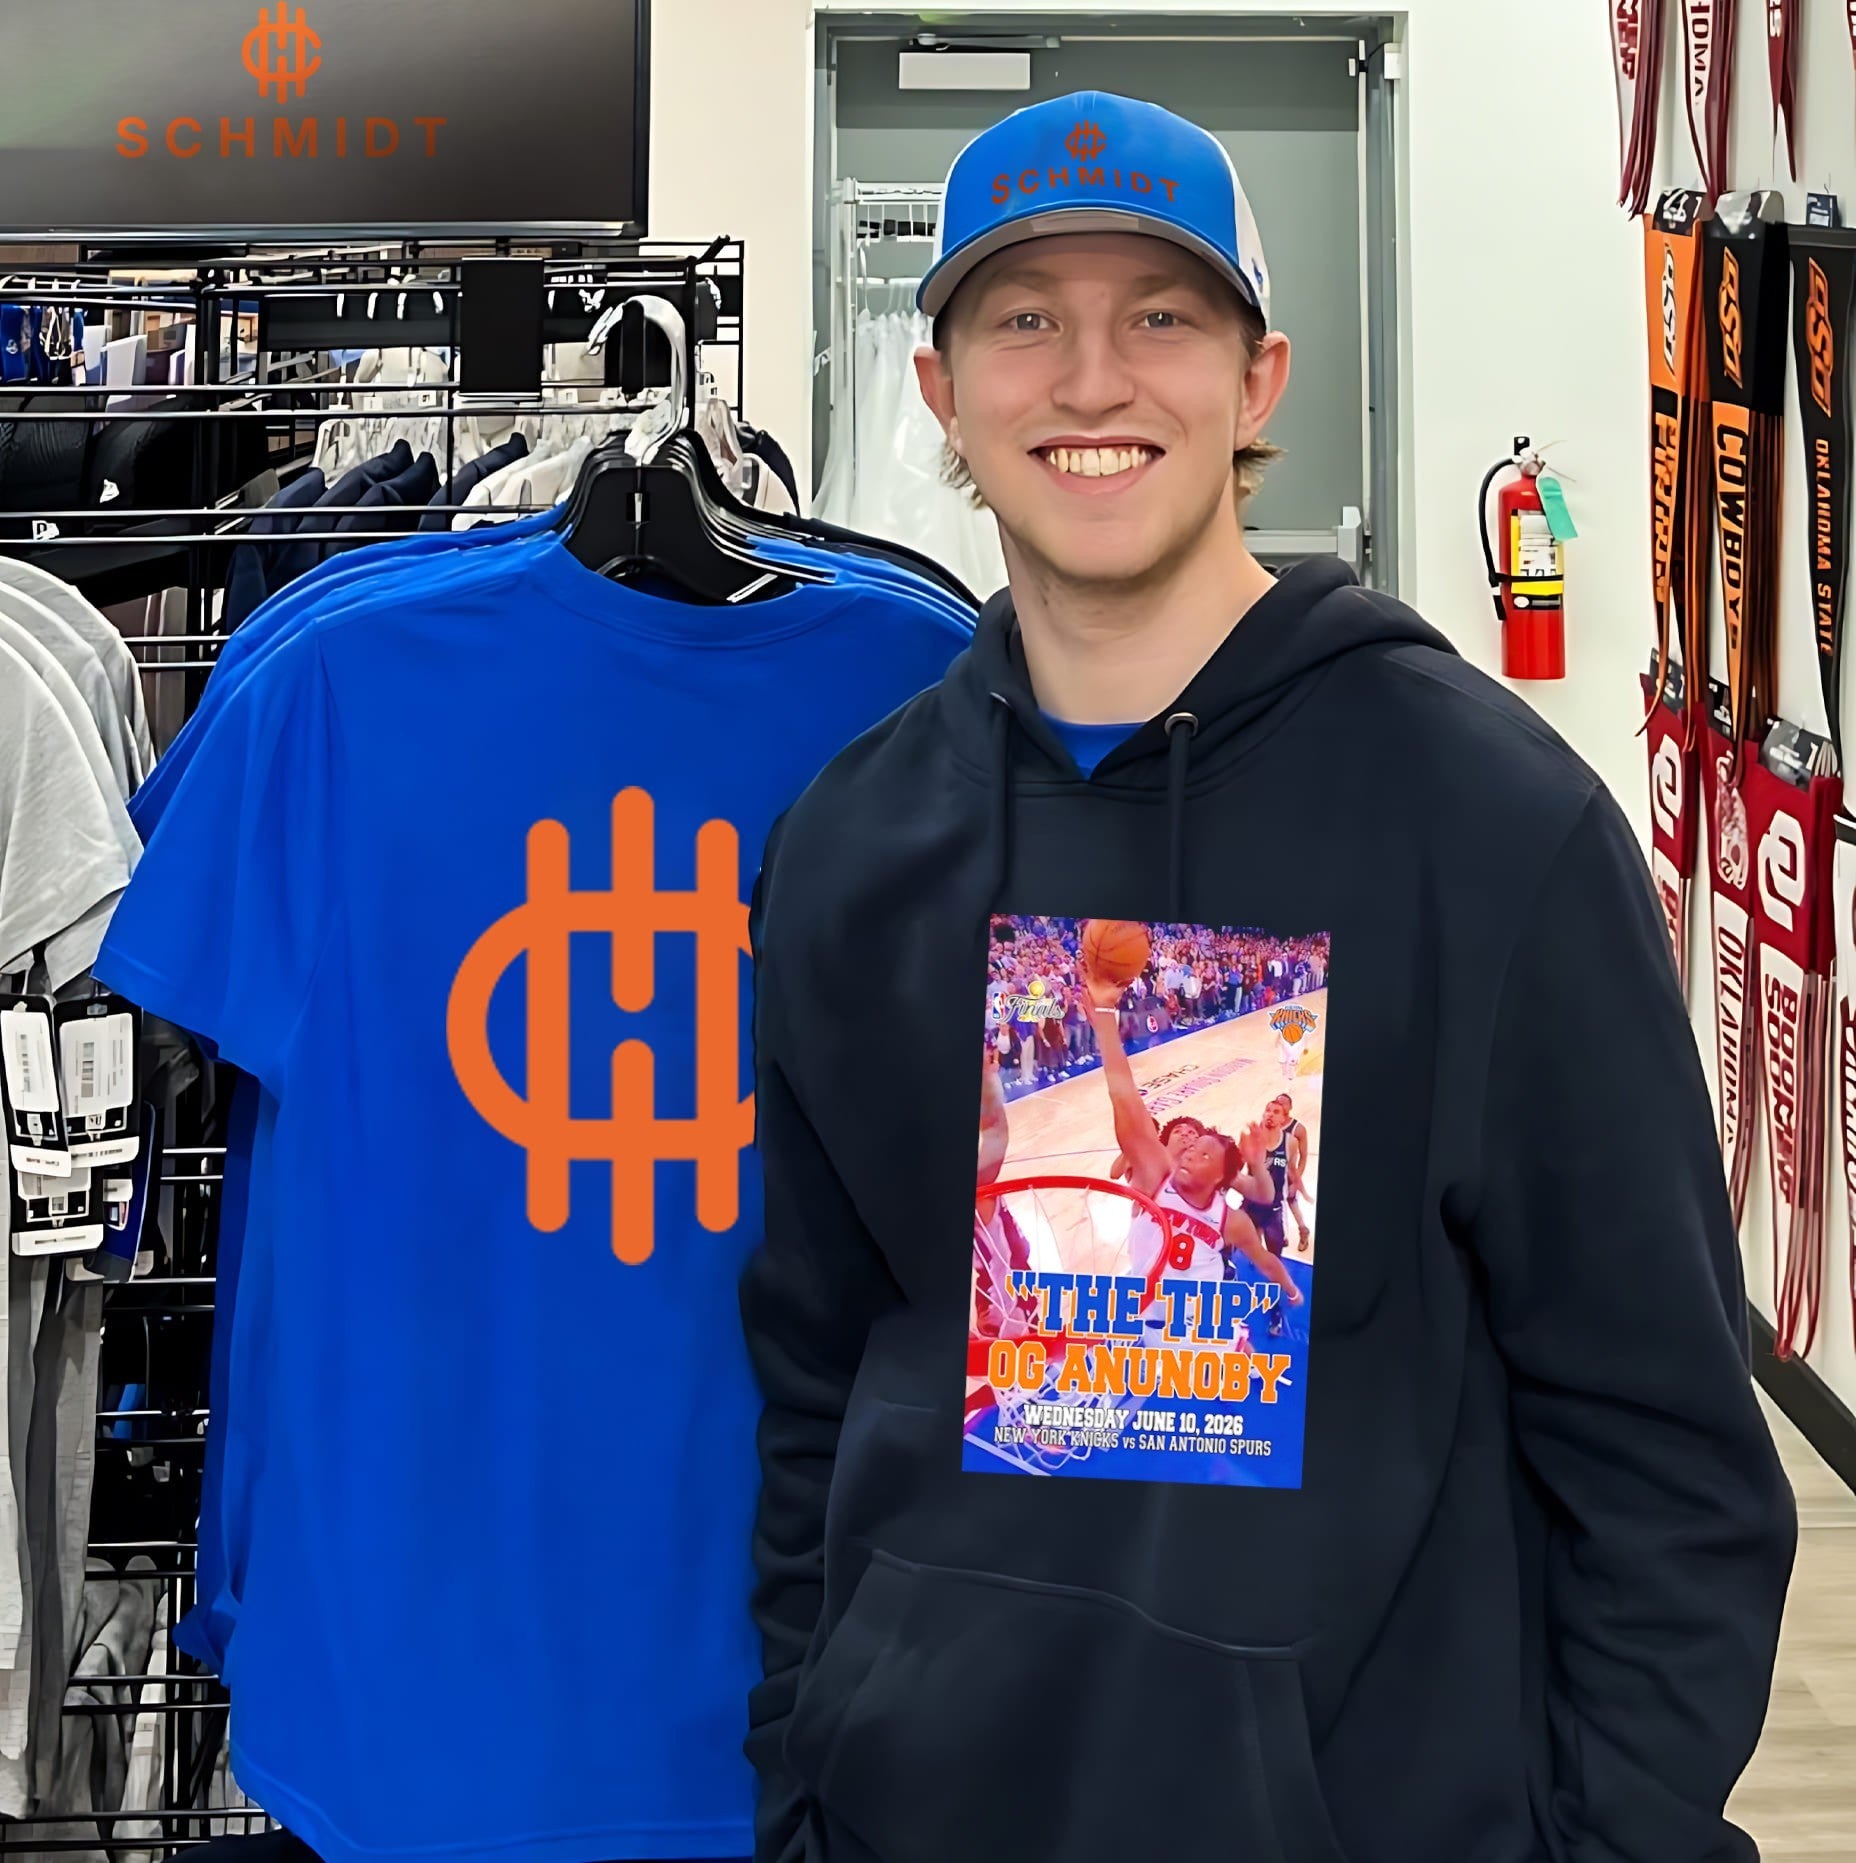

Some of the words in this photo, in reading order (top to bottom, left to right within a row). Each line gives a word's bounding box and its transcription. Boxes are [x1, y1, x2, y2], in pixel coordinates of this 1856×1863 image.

[116, 117, 447, 158] SCHMIDT
[992, 167, 1179, 204] SCHMIDT
[1815, 438, 1832, 571] OKLAHOMA
[1817, 582, 1834, 657] STATE
[1003, 995, 1065, 1023] Finals
[1270, 1007, 1316, 1032] KNICKS
[1718, 925, 1746, 1144] OKLAHOMA
[1168, 1232, 1195, 1271] 8
[988, 1340, 1047, 1390] OG
[1056, 1343, 1291, 1403] ANUNOBY
[1023, 1403, 1130, 1430] WEDNESDAY
[1132, 1410, 1177, 1432] JUNE
[1179, 1412, 1200, 1436] 10,
[1203, 1413, 1244, 1436] 2026
[994, 1426, 1027, 1443] NEW
[1030, 1428, 1067, 1446] YORK
[1070, 1430, 1119, 1448] KNICKS
[1138, 1433, 1166, 1450] SAN
[1169, 1435, 1227, 1454] ANTONIO
[1229, 1439, 1272, 1456] SPURS
